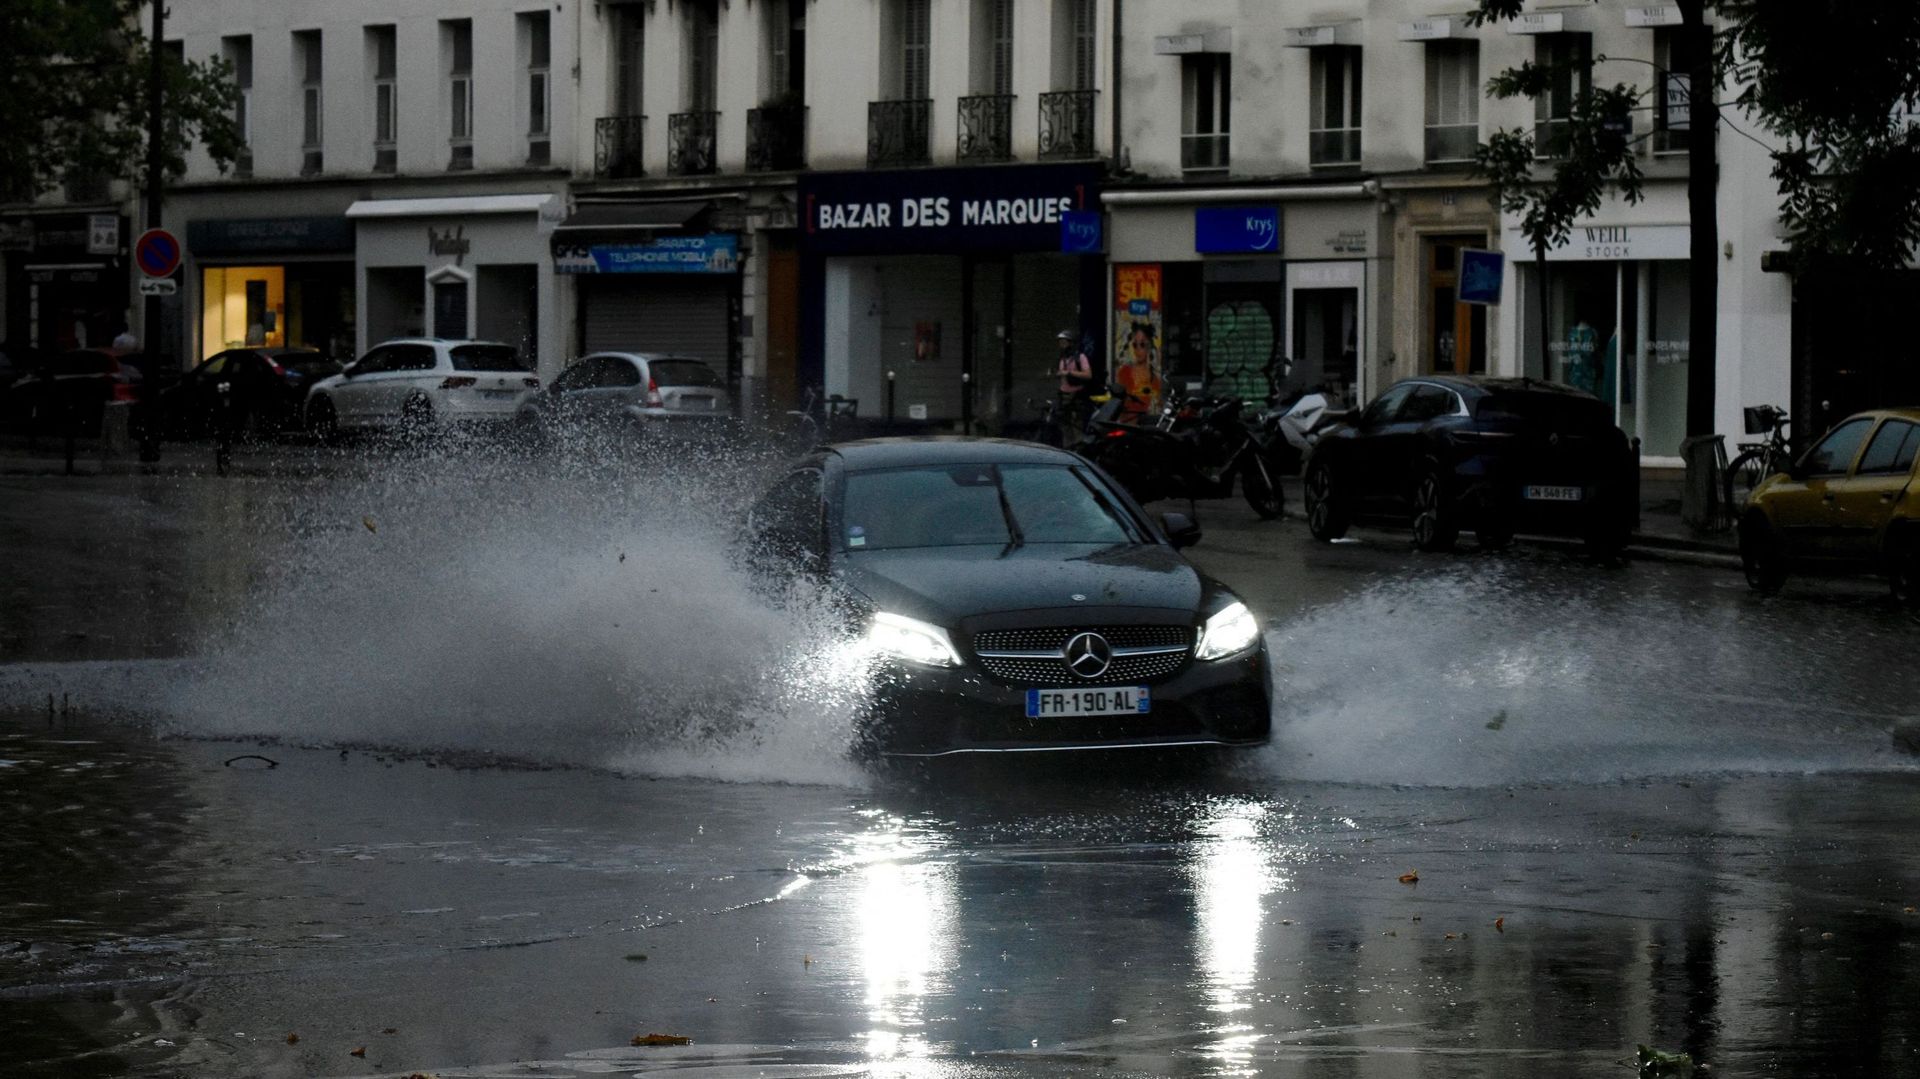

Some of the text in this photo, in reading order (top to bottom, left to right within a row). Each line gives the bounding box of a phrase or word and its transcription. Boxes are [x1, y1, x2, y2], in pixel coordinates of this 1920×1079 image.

[819, 197, 1072, 229] BAZAR DES MARQUES
[1068, 220, 1097, 239] Krys
[1246, 215, 1273, 236] Krys
[1584, 226, 1632, 244] WEILL
[1585, 246, 1630, 258] STOCK
[1119, 281, 1159, 303] SUN
[1040, 691, 1136, 713] FR-190-AL
